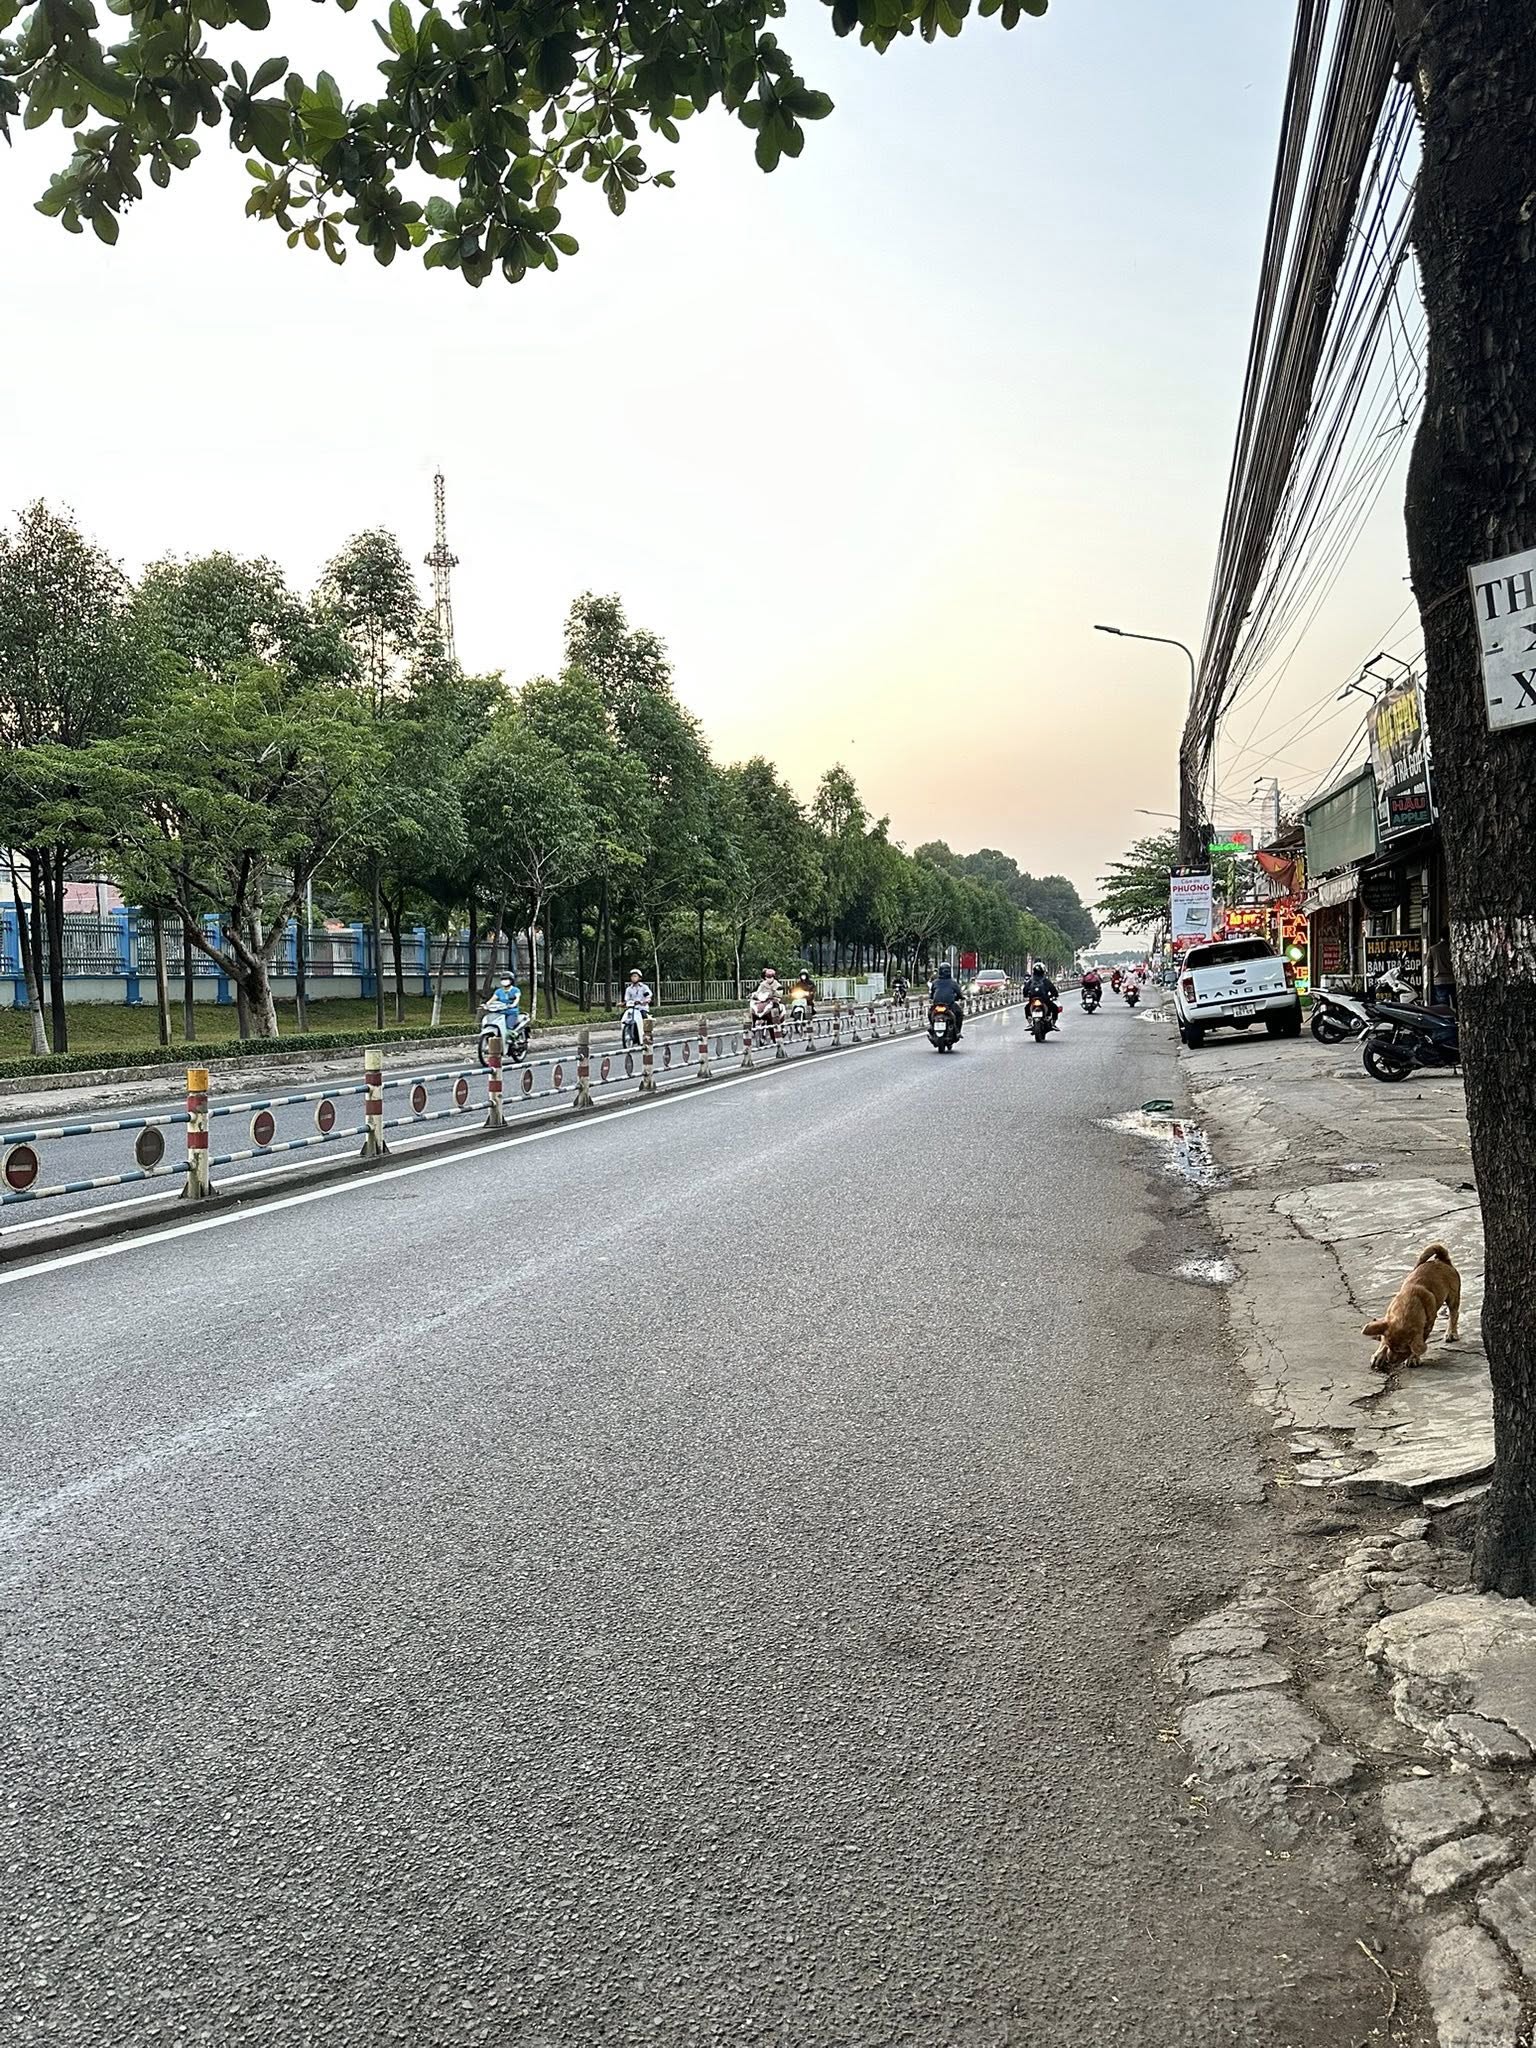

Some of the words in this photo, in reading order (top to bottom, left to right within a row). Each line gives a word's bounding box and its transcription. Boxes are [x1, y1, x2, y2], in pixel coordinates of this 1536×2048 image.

[1392, 811, 1427, 825] APPLE
[1172, 884, 1210, 892] PHƯƠNG
[1388, 940, 1420, 954] APPLE
[1198, 982, 1284, 1000] RANGER
